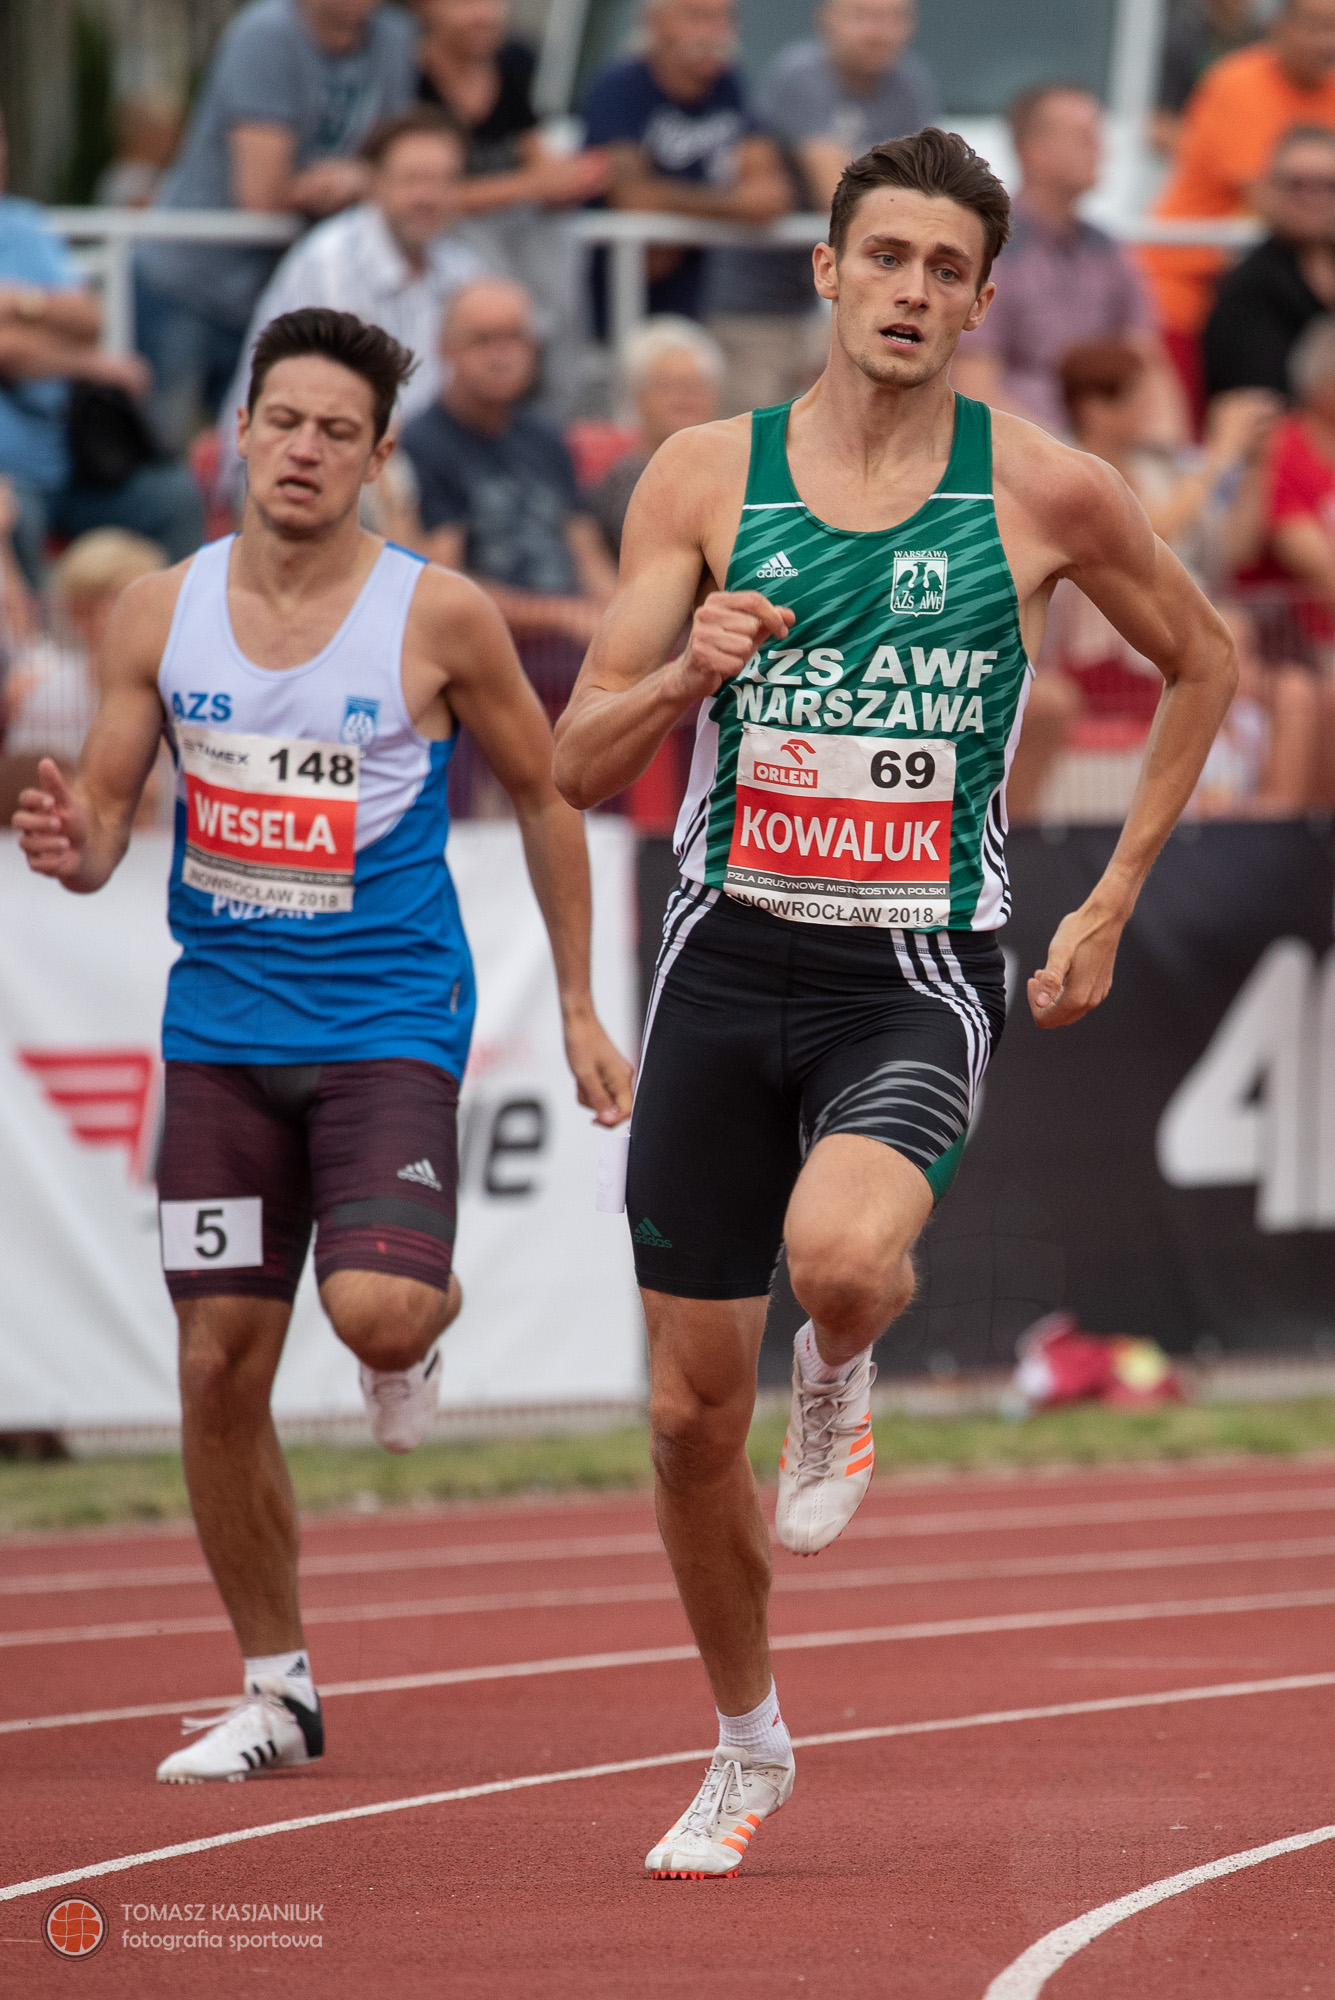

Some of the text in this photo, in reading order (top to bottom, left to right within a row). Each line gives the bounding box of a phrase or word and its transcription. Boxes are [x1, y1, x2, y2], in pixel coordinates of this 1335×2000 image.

[893, 550, 948, 558] WARSZAWA
[756, 567, 799, 579] adidas
[893, 590, 942, 610] AZS AWF
[737, 645, 999, 689] AZS AWF
[731, 683, 985, 734] WARSZAWA
[269, 748, 355, 787] 148
[756, 764, 814, 786] ORLEN
[870, 749, 936, 790] 69
[194, 791, 337, 855] WESELA
[740, 805, 941, 862] KOWALUK
[726, 871, 946, 896] PZLA DRUŻYNOWE MISTRZOSTWA POLSKI
[298, 892, 340, 908] 2018
[888, 906, 934, 923] 2018
[195, 1208, 228, 1259] 5
[632, 1233, 673, 1249] adidas
